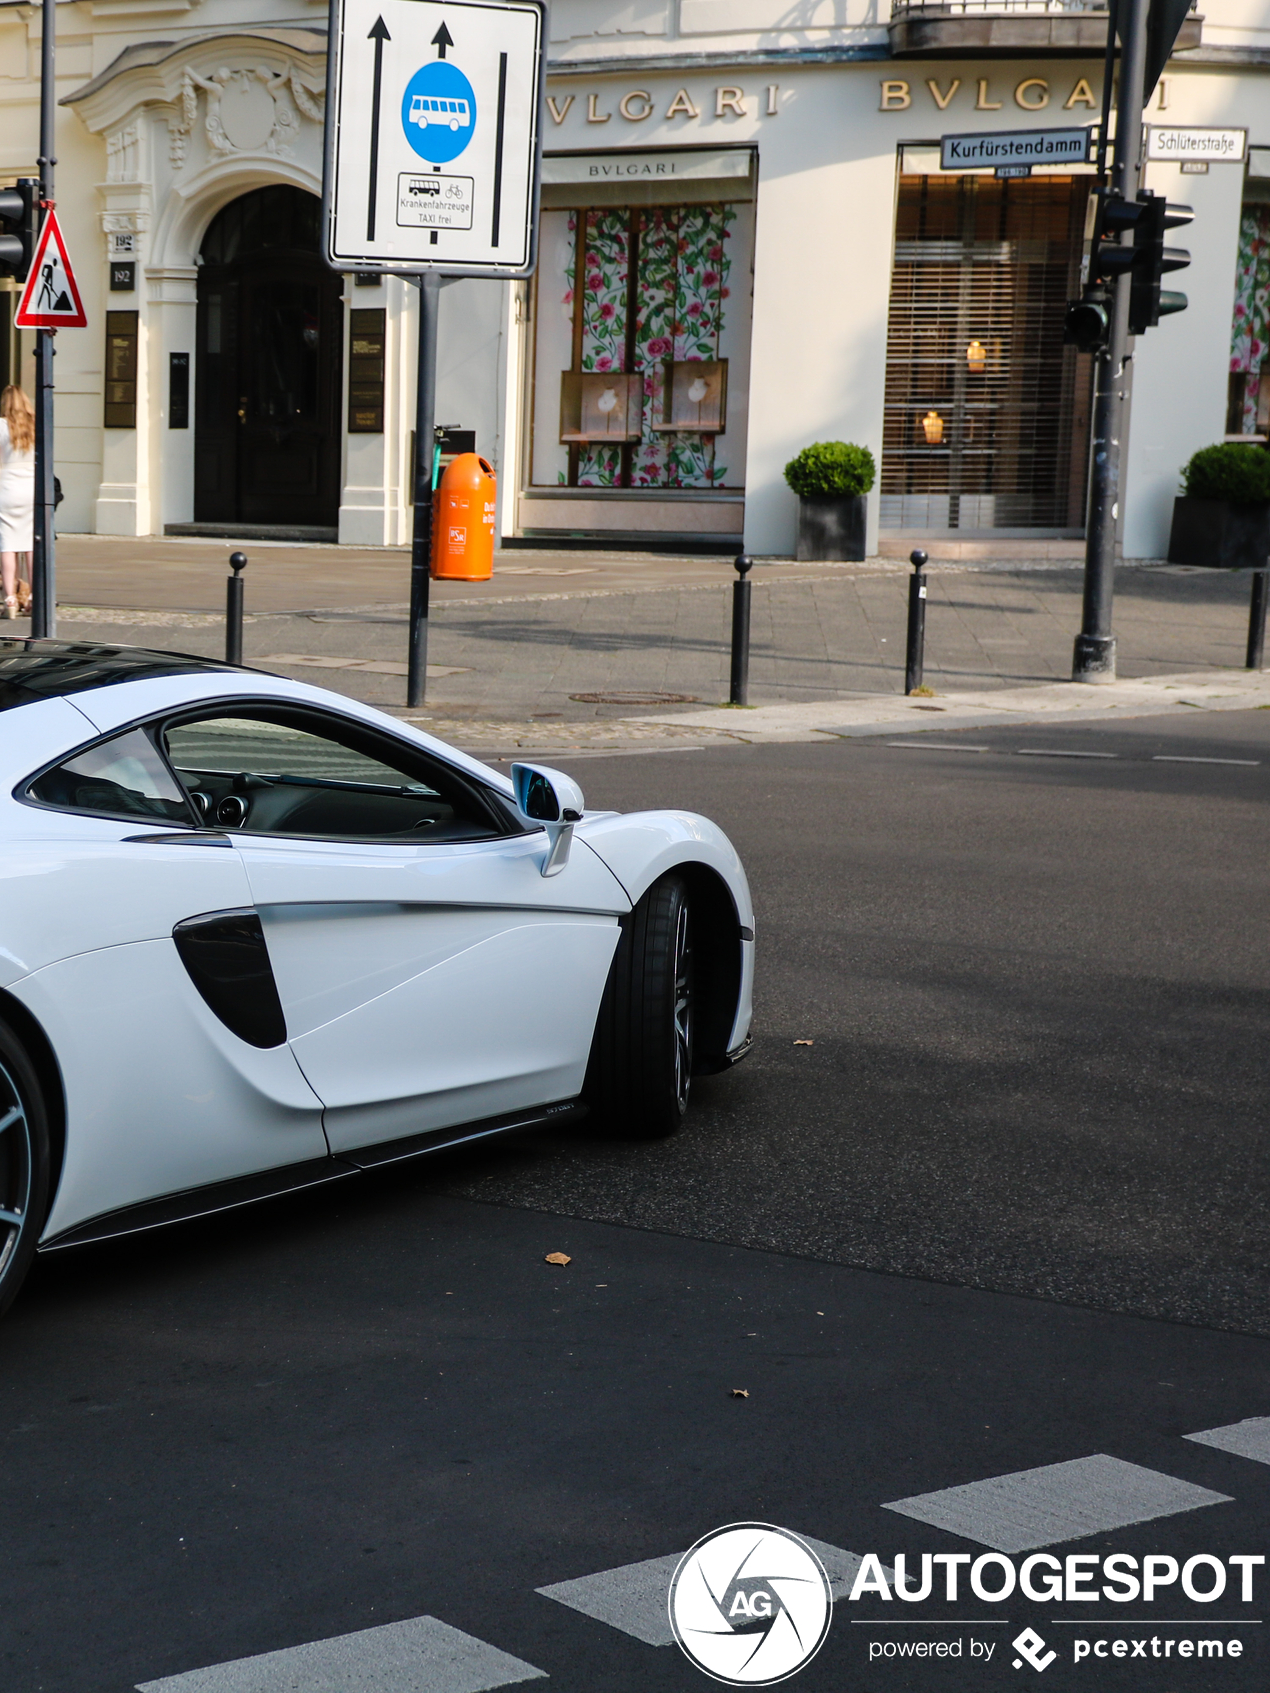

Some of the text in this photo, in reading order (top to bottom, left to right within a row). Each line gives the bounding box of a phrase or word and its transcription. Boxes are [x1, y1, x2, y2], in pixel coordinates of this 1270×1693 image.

[878, 78, 1172, 111] BVLGAI
[545, 85, 780, 125] VLGARI
[950, 137, 1082, 159] Kurfürstendamm
[1157, 133, 1235, 154] Schlüterstraße
[589, 162, 676, 177] BVLGARI
[400, 198, 470, 213] Krankenfahrzeuge
[418, 213, 452, 224] TAXI frei
[115, 234, 133, 248] 192
[114, 270, 131, 282] 192
[449, 529, 465, 542] BSR
